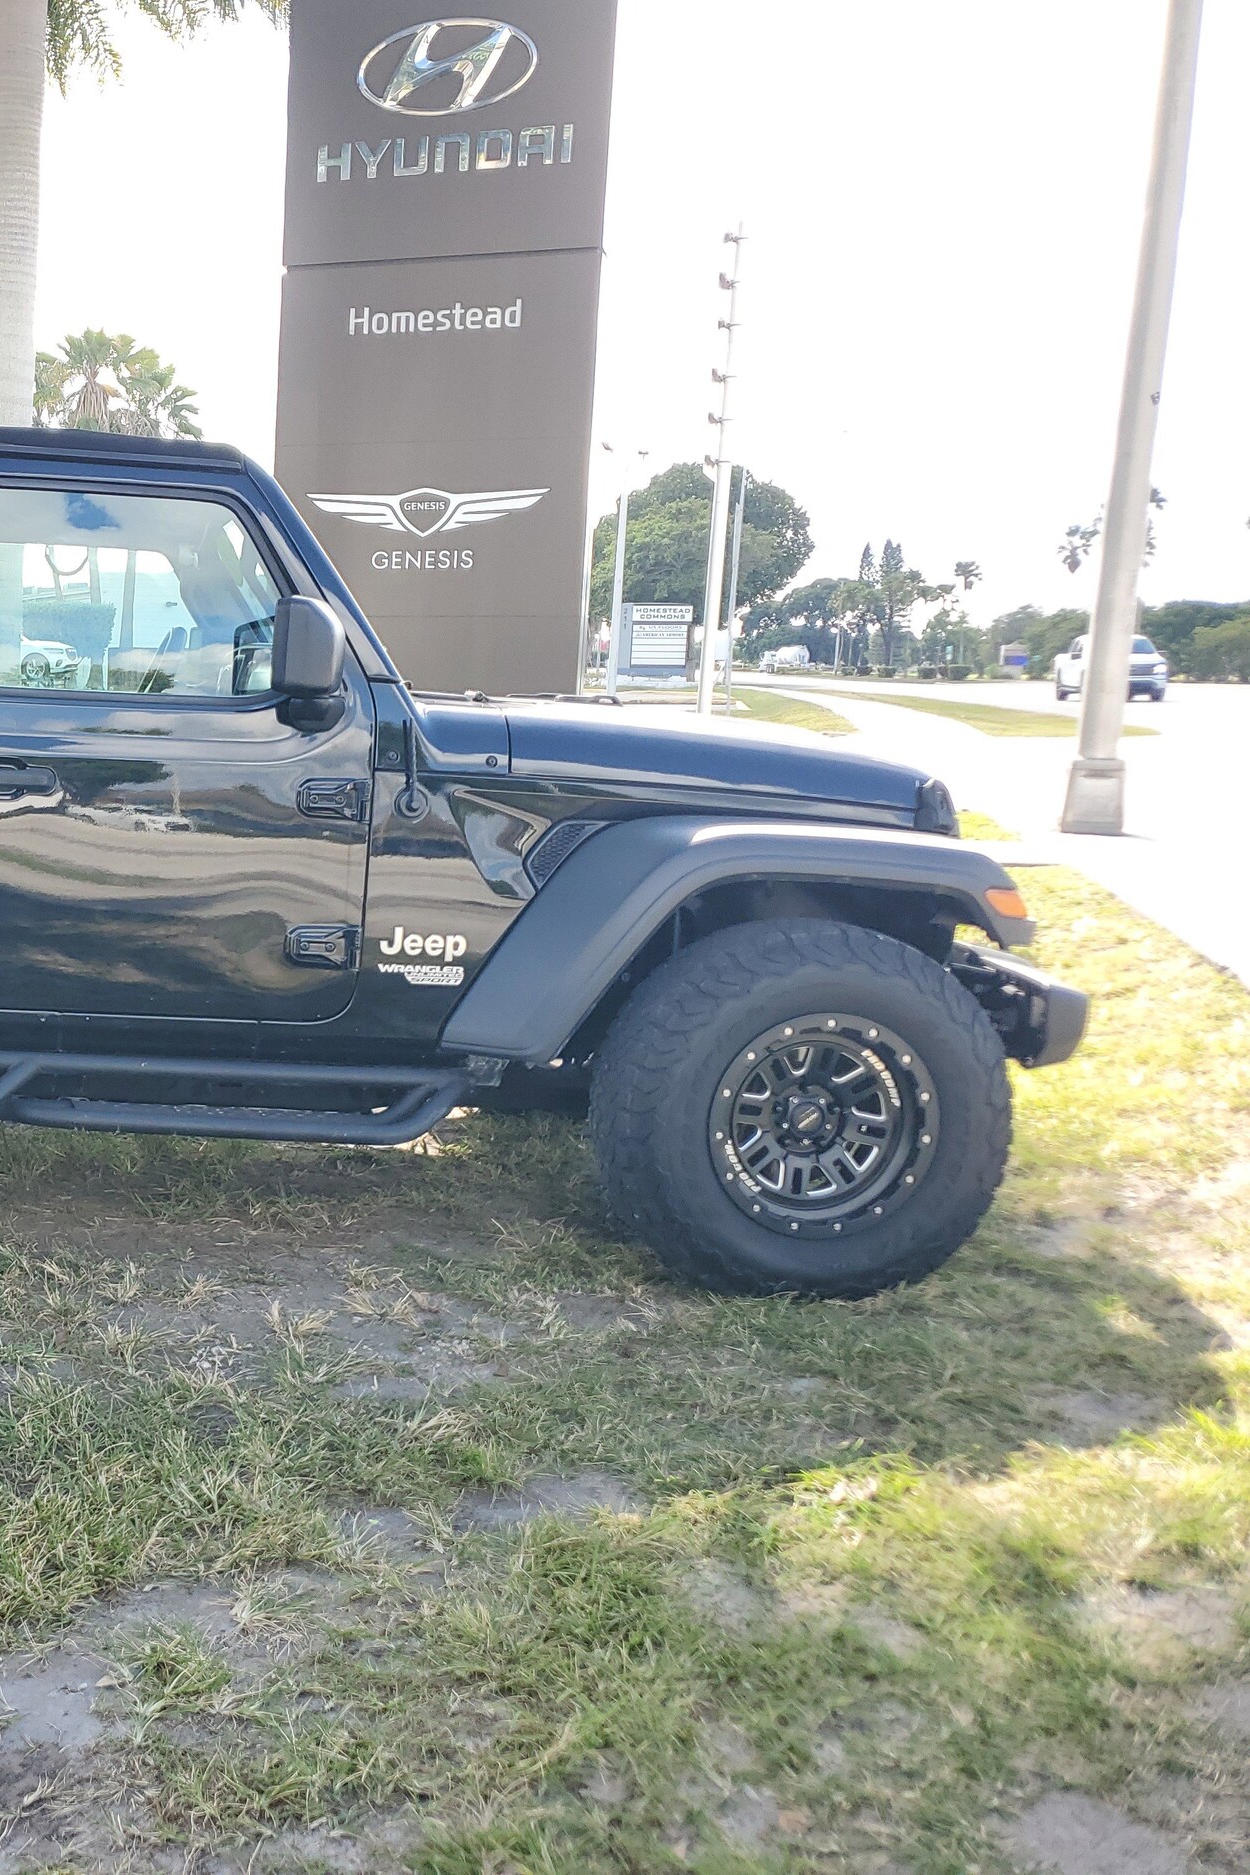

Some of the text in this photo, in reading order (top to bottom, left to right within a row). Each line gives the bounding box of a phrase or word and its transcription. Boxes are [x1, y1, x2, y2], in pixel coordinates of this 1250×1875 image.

[317, 123, 574, 182] HYUNDAI
[349, 298, 523, 335] Homestead
[404, 500, 446, 512] GENESIS
[371, 549, 474, 570] GENESIS
[379, 926, 468, 962] Jeep
[377, 963, 465, 974] WRANGLER
